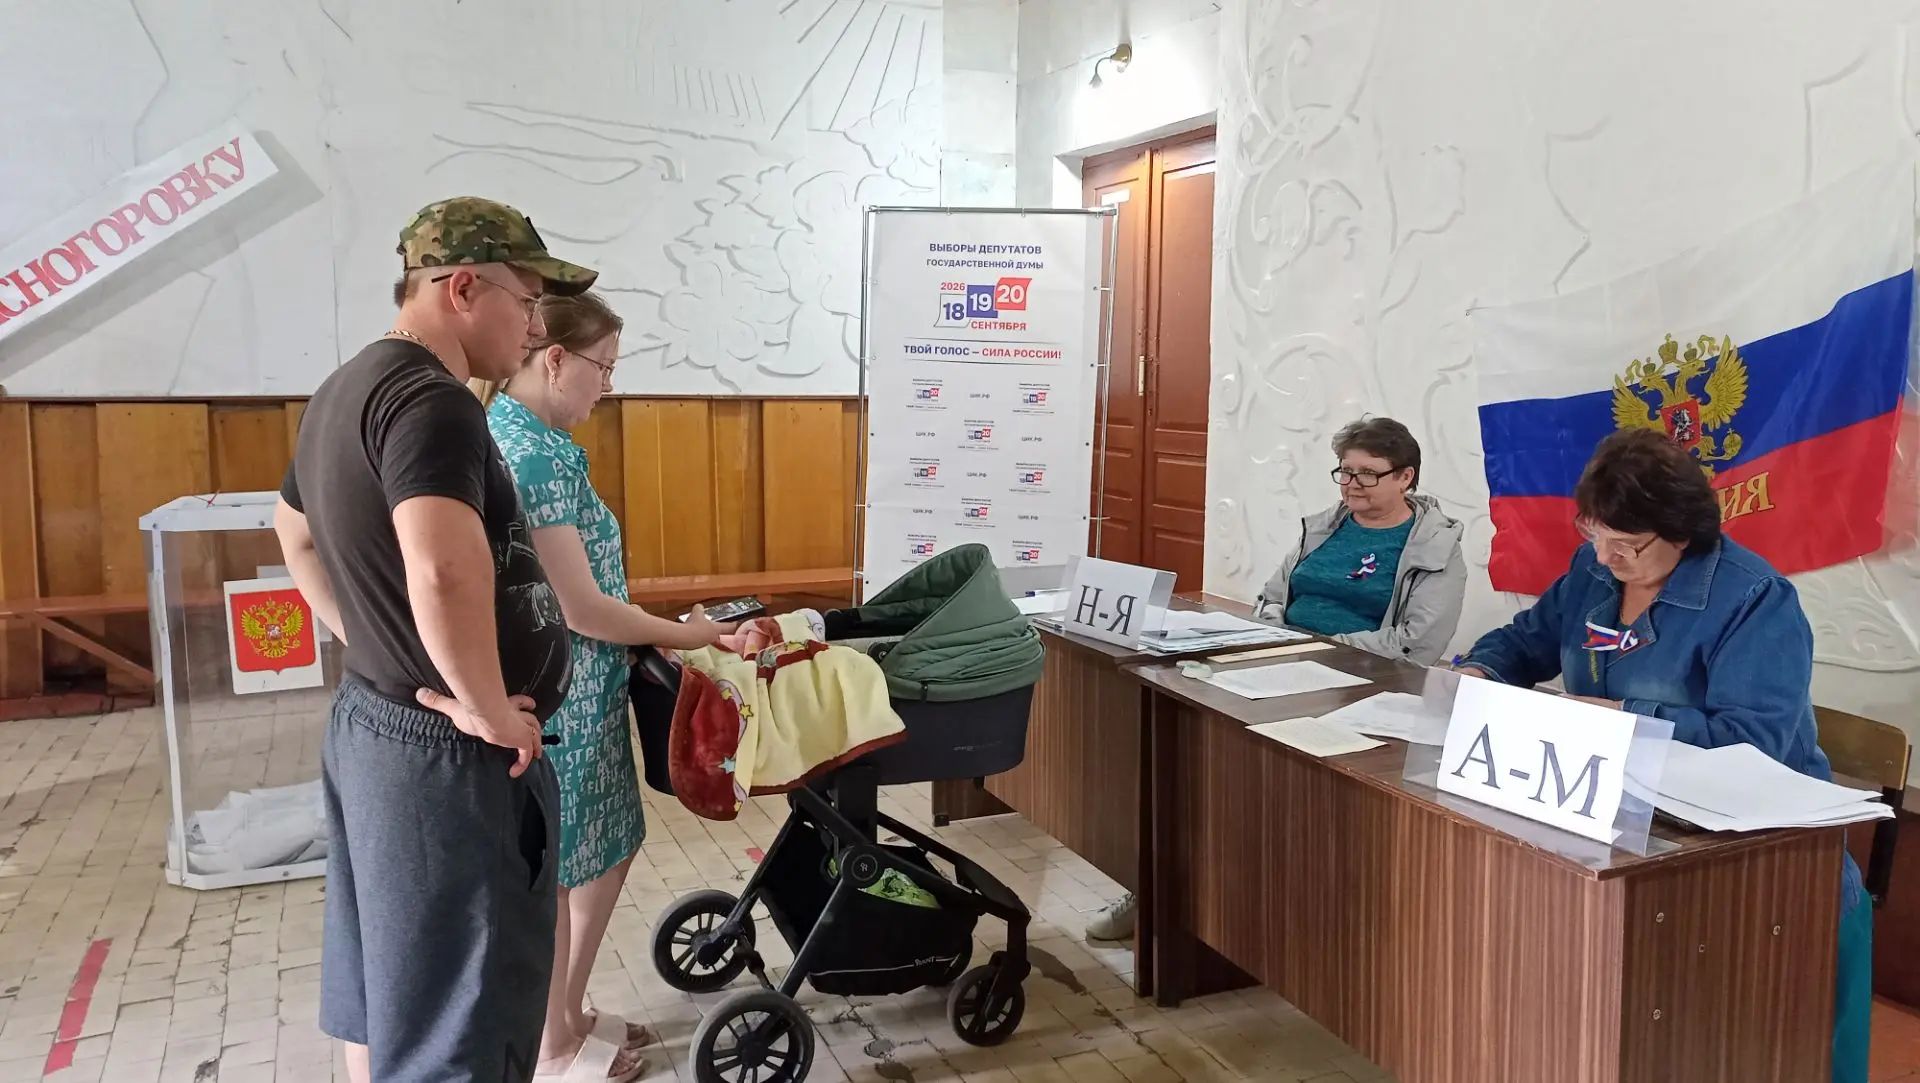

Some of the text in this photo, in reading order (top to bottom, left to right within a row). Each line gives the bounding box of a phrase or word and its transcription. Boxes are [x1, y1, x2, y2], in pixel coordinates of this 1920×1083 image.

[0, 137, 245, 324] СНОГОРОВКУ
[929, 243, 1042, 255] ВЫБОРЫ ДЕПУТАТОВ
[926, 258, 1044, 270] ГОСУДАРСТВЕННОЙ ДУМЫ
[940, 282, 966, 291] 2026
[943, 284, 1025, 321] 18 19 20
[970, 320, 1027, 331] СЕНТЯБРЯ
[904, 344, 932, 355] ТВОЙ
[934, 346, 970, 357] ГОЛОС
[982, 348, 1012, 358] СИЛА
[1013, 349, 1062, 359] РОССИИ!
[1073, 584, 1138, 636] Н-Я
[1450, 722, 1609, 820] А-М
